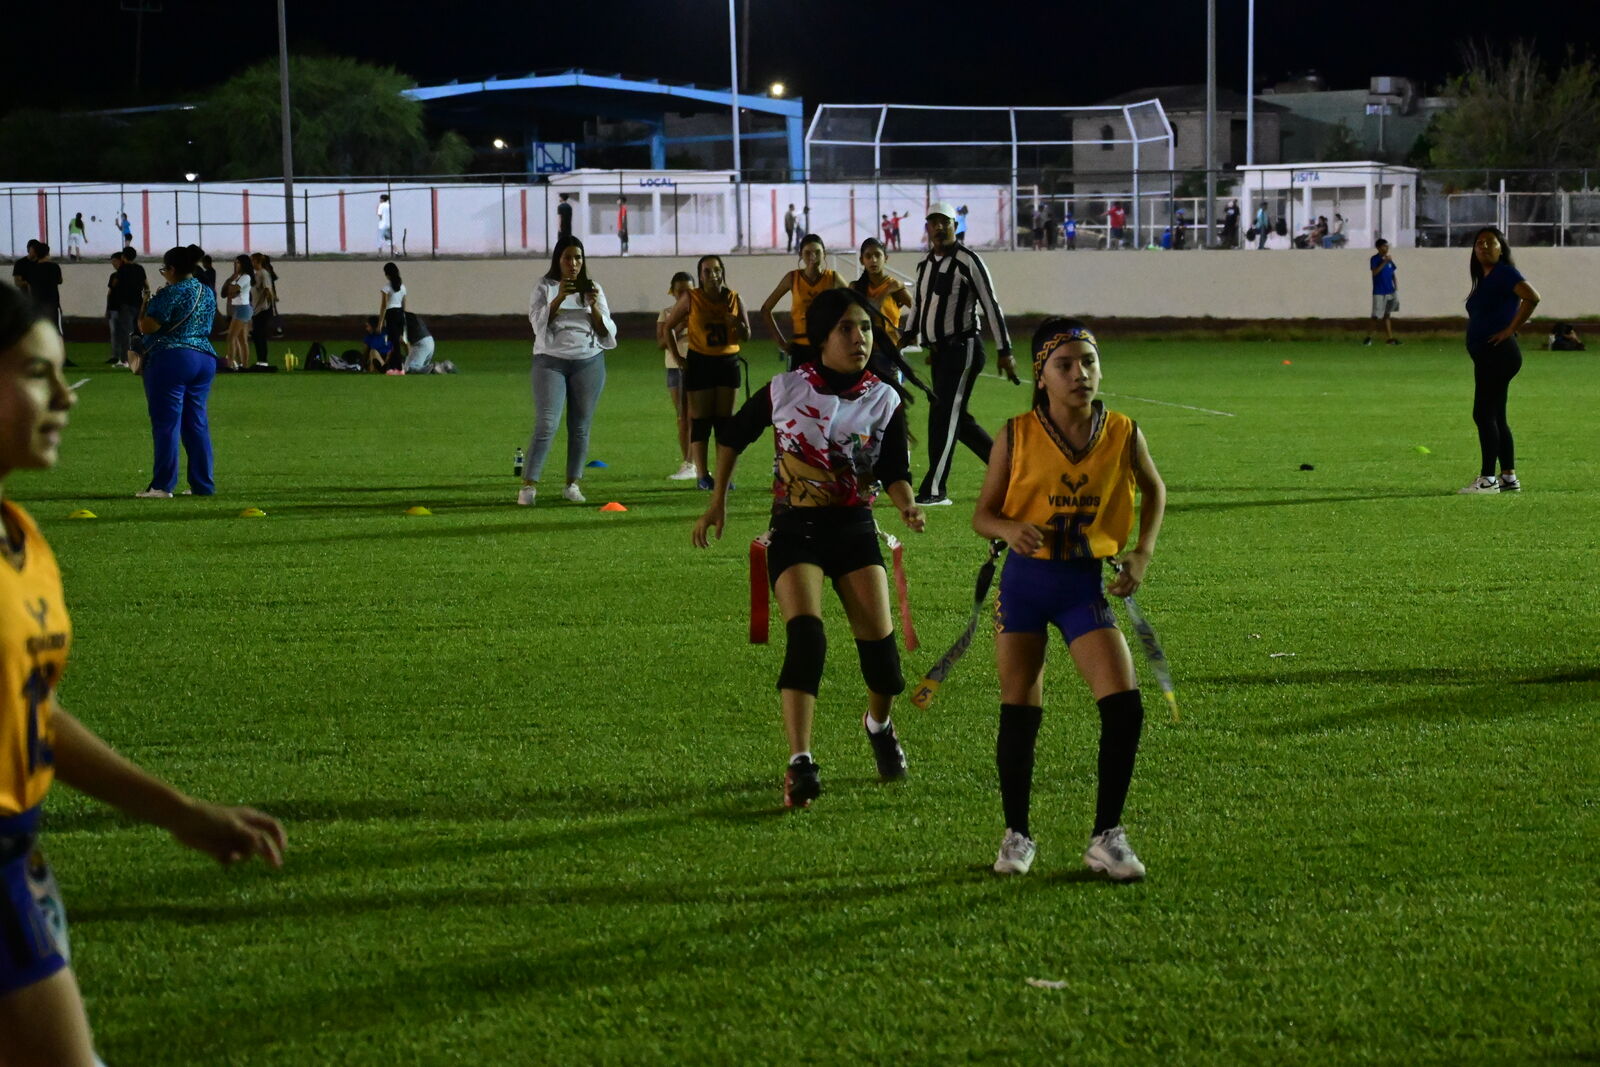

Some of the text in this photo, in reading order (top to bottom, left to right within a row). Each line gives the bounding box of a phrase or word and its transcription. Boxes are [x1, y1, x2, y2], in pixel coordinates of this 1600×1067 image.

[1292, 171, 1320, 182] VISITA
[640, 178, 673, 187] LOCAL
[1048, 495, 1100, 507] VENADOS
